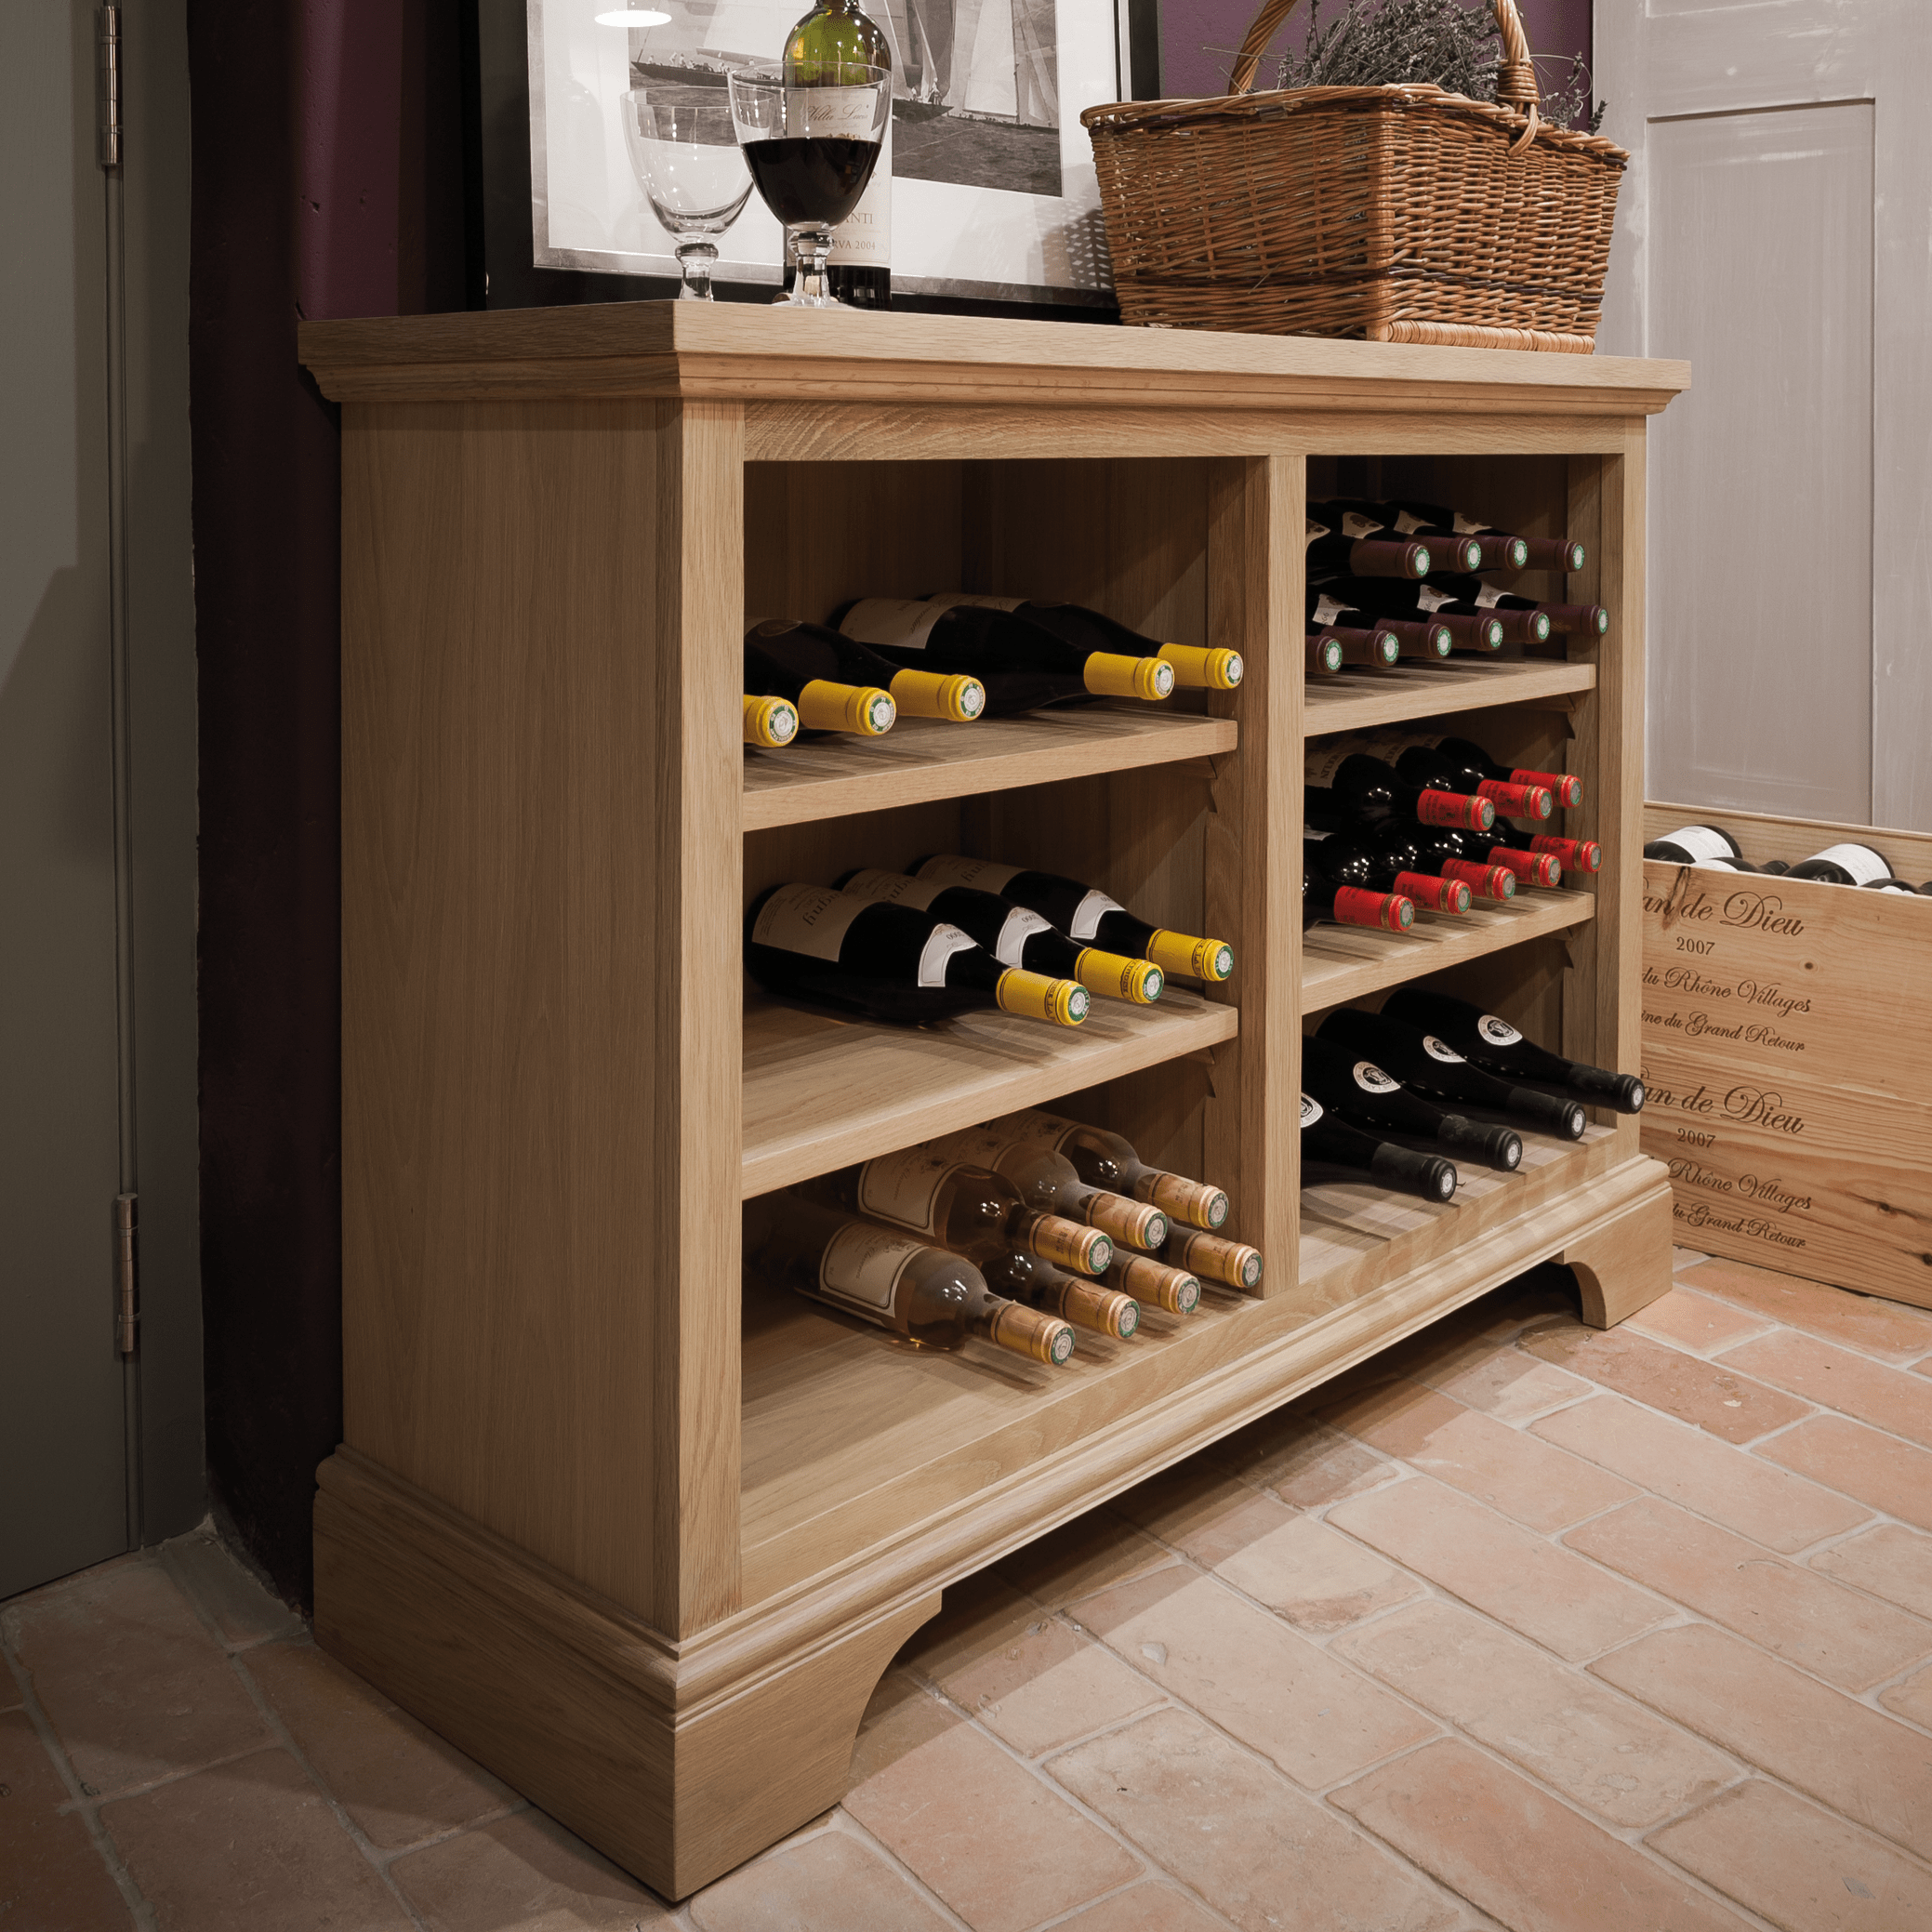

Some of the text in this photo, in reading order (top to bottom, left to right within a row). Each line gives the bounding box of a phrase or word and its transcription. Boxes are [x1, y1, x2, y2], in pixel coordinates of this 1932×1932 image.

[807, 104, 836, 122] Villa
[854, 240, 876, 250] 2004
[1680, 893, 1713, 920] de
[1719, 892, 1805, 936] Dieu
[1676, 936, 1715, 955] 2007
[1642, 967, 1811, 1018] du Rhône Villages
[1641, 1010, 1805, 1052] ine du Grand Retour
[1681, 1086, 1714, 1113] de
[1719, 1086, 1805, 1133] Dieu
[1677, 1128, 1715, 1148] 2007
[1667, 1158, 1812, 1213] Rhône Villages
[1687, 1202, 1743, 1233] Grand
[1746, 1218, 1806, 1248] Retour
